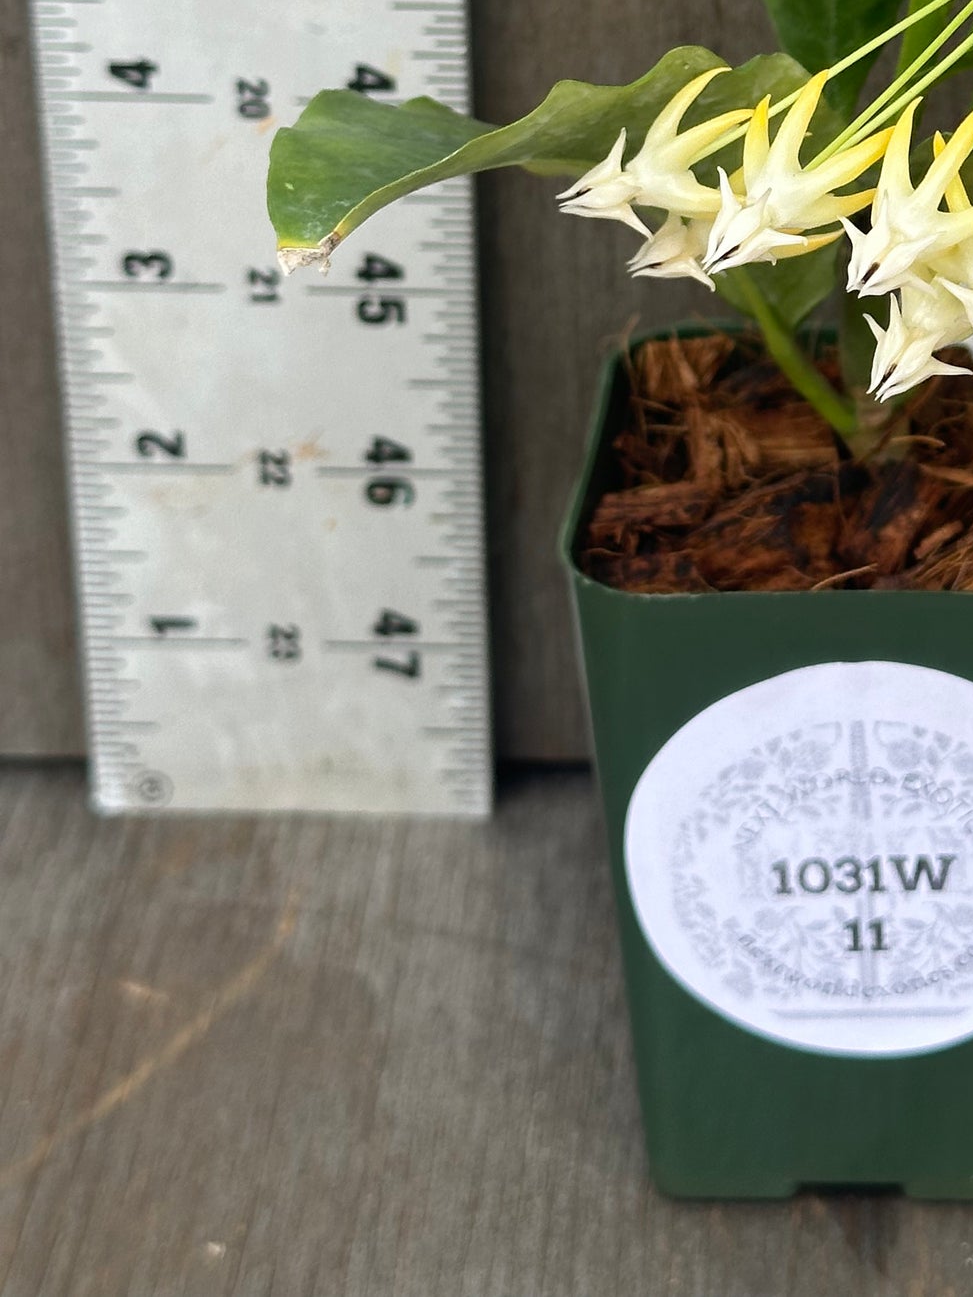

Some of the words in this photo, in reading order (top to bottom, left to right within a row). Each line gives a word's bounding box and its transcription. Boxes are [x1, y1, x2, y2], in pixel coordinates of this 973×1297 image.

[108, 59, 159, 90] 4
[236, 76, 270, 119] 20
[121, 252, 173, 279] 3
[247, 267, 281, 303] 21
[356, 254, 408, 326] 45
[136, 429, 187, 459] 2
[257, 448, 292, 488] 22
[364, 435, 414, 509] 46
[147, 615, 195, 638] 1
[373, 607, 420, 681] 47
[770, 854, 957, 895] 1031W
[842, 916, 891, 952] 11
